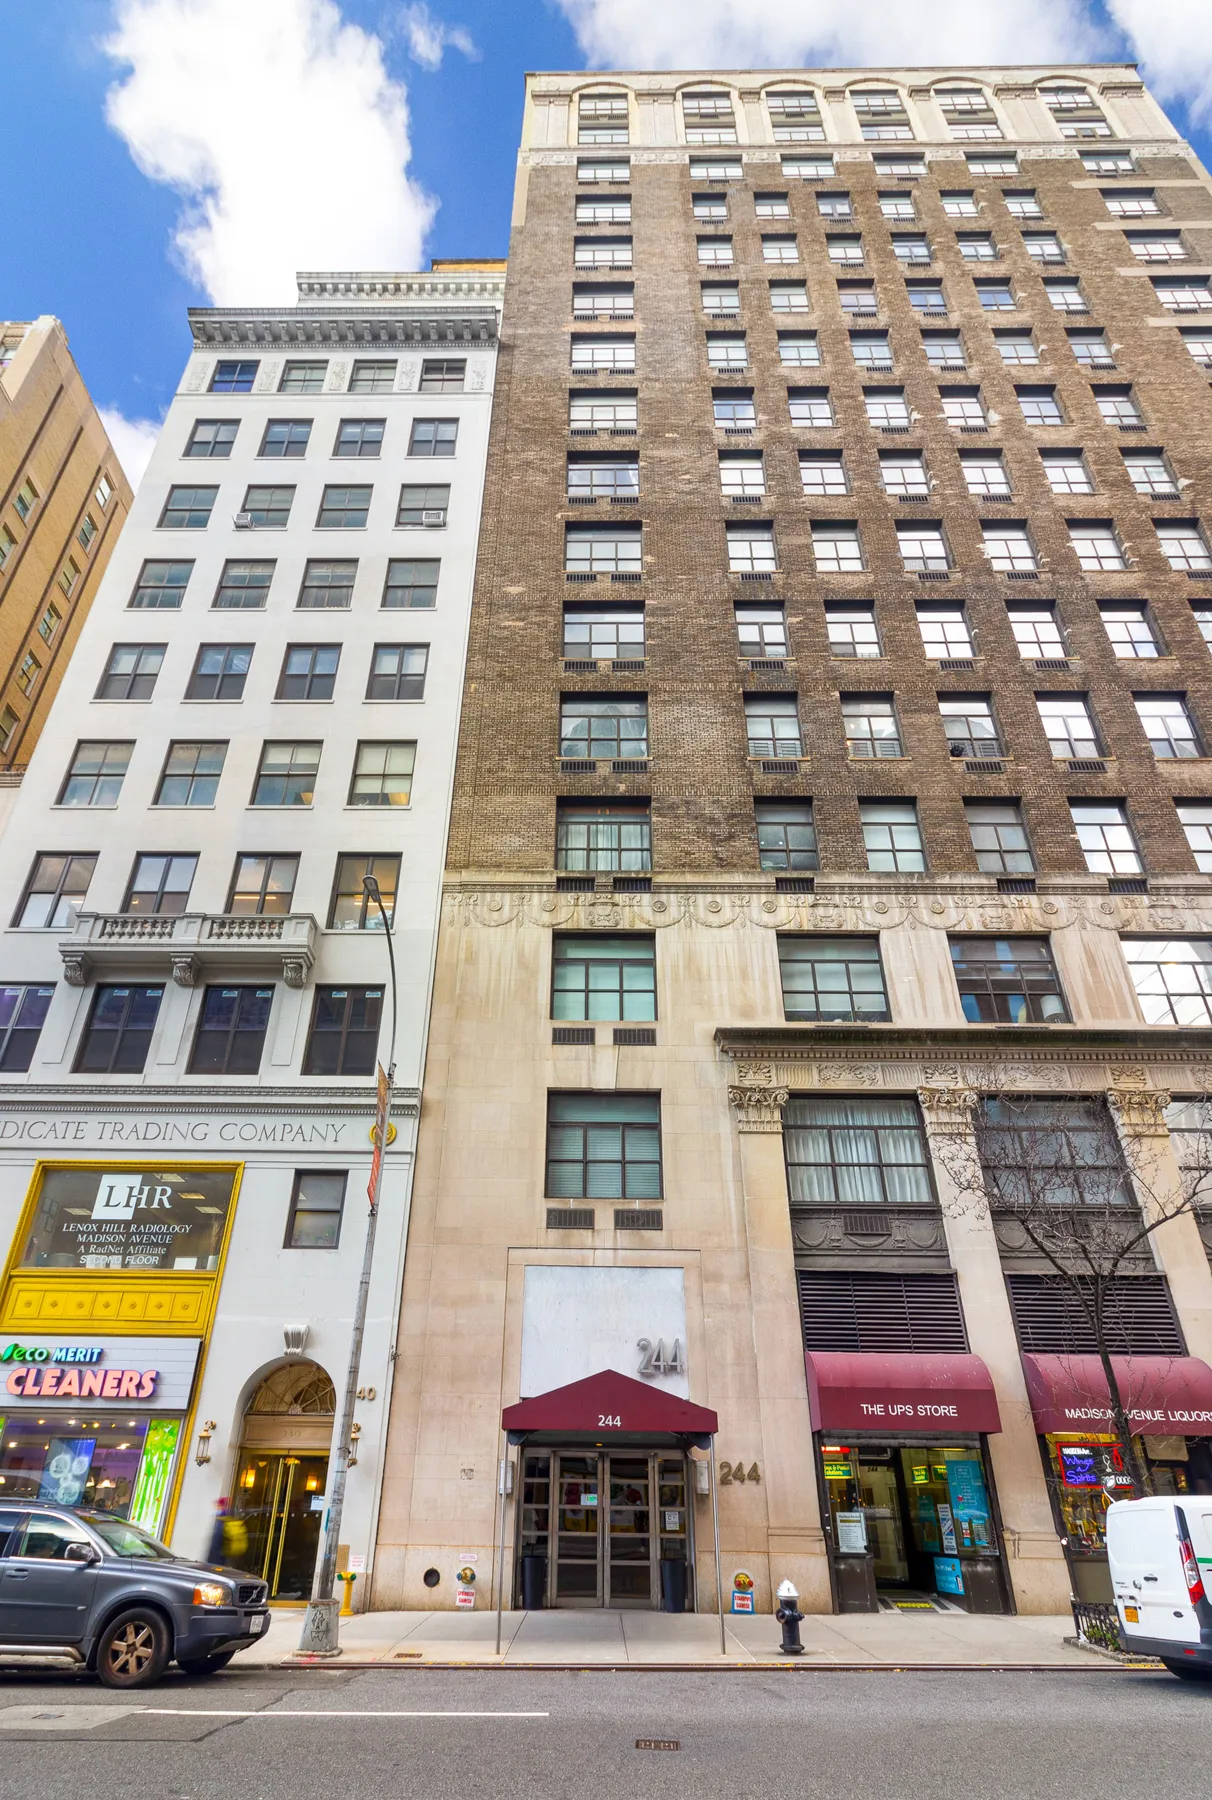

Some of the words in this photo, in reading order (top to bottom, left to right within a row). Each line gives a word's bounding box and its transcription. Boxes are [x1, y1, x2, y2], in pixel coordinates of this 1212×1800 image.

[97, 1120, 209, 1142] TRADING
[219, 1121, 347, 1143] COMPANY
[104, 1184, 173, 1209] LHR
[62, 1223, 99, 1232] LENOX
[102, 1223, 127, 1233] HILL
[129, 1224, 193, 1234] RADIOLOGY
[76, 1233, 127, 1243] MADISON
[129, 1234, 173, 1244] AVENUE
[77, 1244, 85, 1253] A
[89, 1244, 124, 1254] RadNet
[126, 1245, 167, 1254] Affiliate
[124, 1255, 160, 1265] FLOOR
[13, 1345, 49, 1362] eco
[52, 1347, 103, 1363] MERIT
[636, 1337, 684, 1374] 244
[6, 1367, 159, 1399] CLEANERS
[356, 1386, 377, 1401] 40
[861, 1403, 885, 1416] THE
[889, 1404, 914, 1417] UPS
[917, 1405, 959, 1417] STORE
[1064, 1408, 1115, 1419] MADISON
[1122, 1409, 1166, 1421] VENUE
[1167, 1410, 1212, 1421] LIQUOR
[597, 1414, 622, 1428] 244
[719, 1461, 761, 1486] 244
